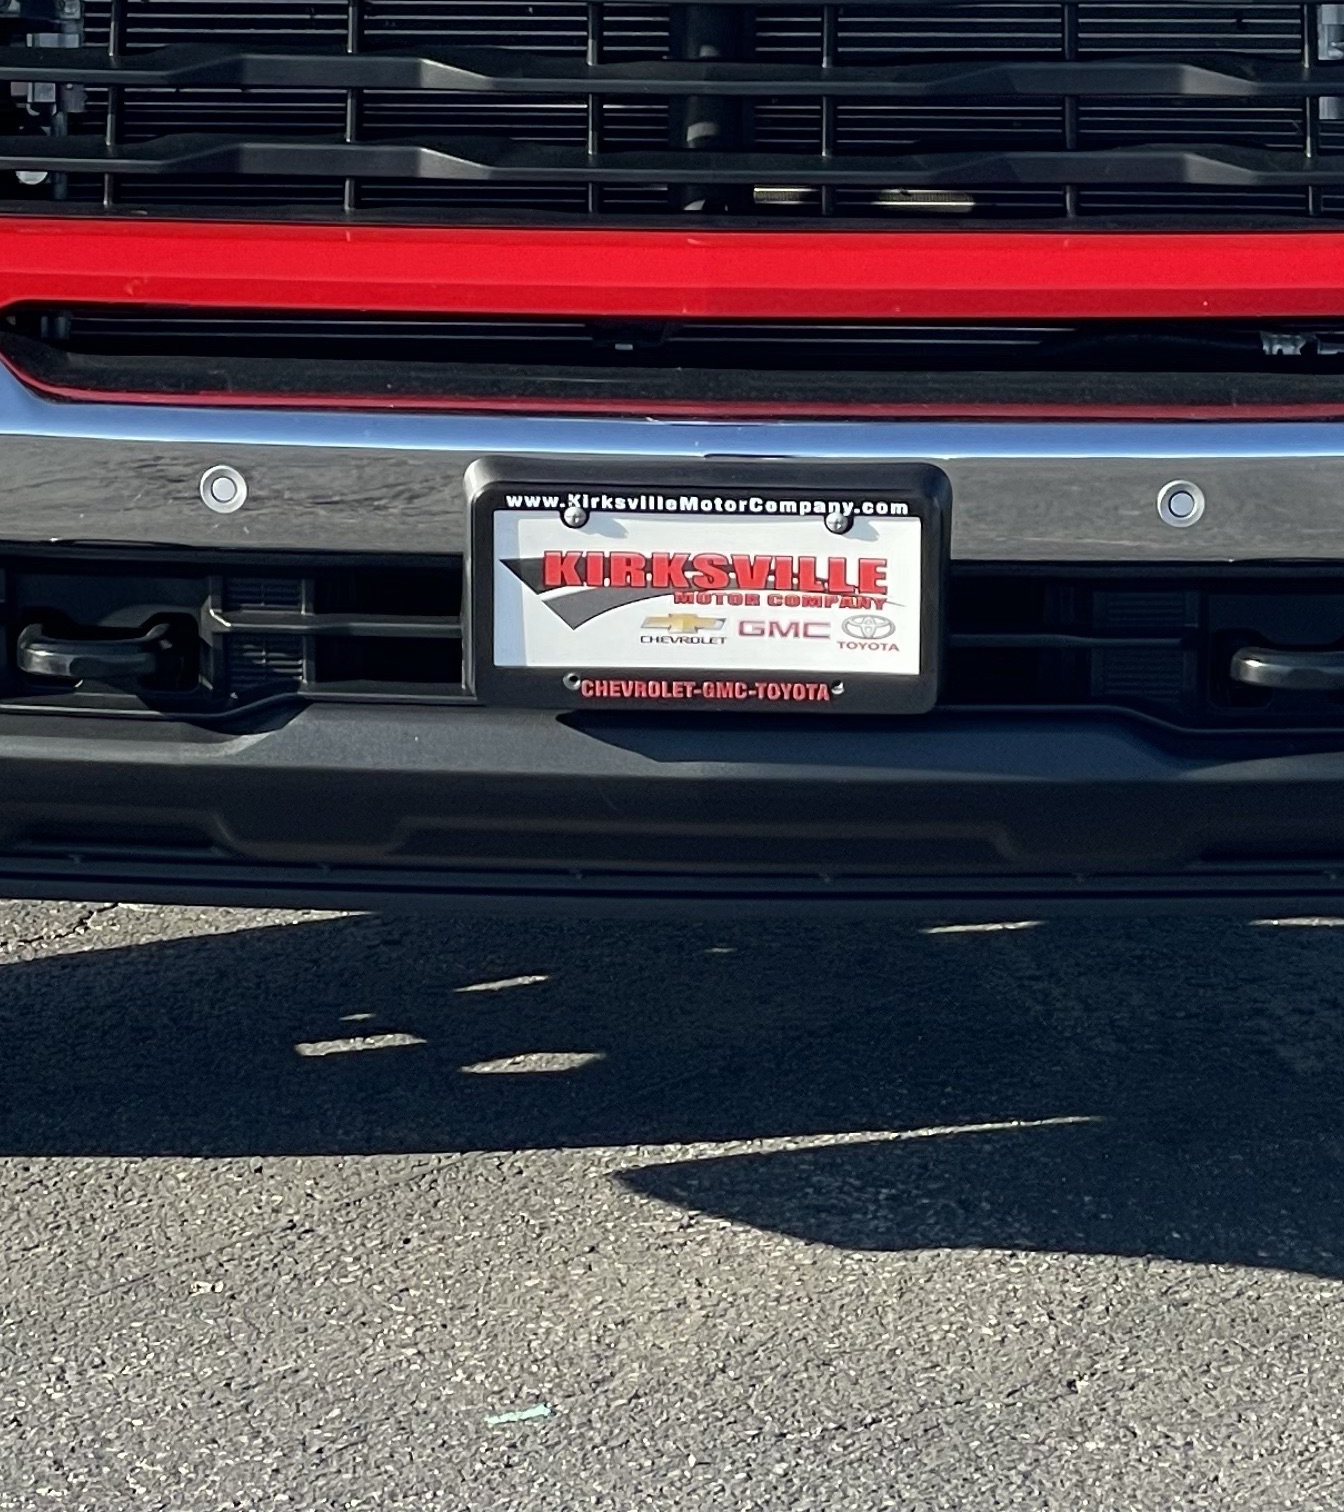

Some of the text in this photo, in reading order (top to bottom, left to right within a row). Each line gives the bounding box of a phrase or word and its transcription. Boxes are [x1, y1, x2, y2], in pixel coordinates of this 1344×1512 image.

[506, 494, 909, 515] www.KirksvilleMotorCompany.com
[543, 552, 889, 595] KIRKSVILLE
[673, 592, 887, 610] MOTOR COMPANY
[738, 620, 831, 639] GMC
[640, 635, 727, 645] CHEVROLET
[837, 641, 900, 652] TOYOTA
[581, 679, 830, 702] CHEVROLET-GMC-TOYOTA
